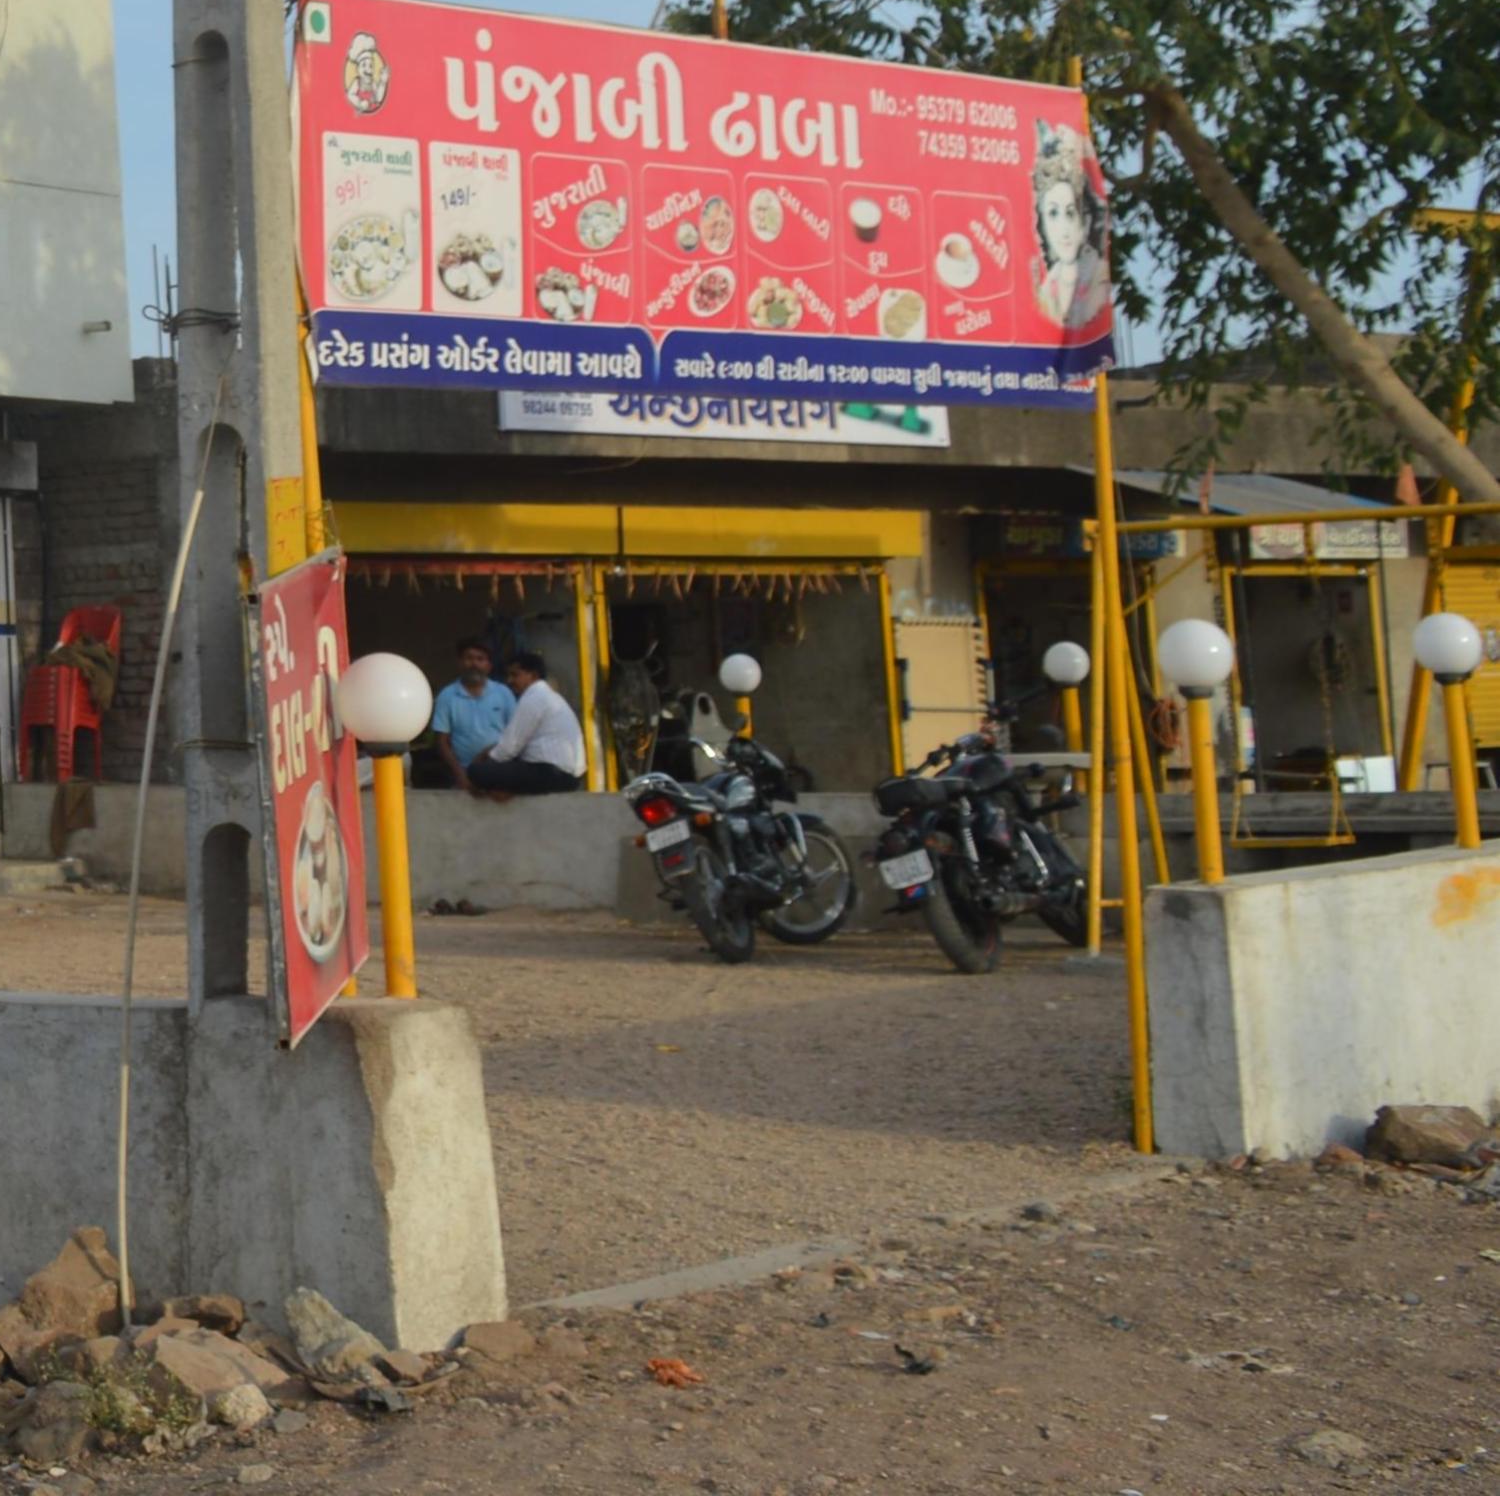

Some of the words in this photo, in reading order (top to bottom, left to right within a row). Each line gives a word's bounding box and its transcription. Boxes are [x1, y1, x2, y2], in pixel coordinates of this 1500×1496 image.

[444, 28, 688, 152] પંજાબી
[709, 89, 863, 169] ઢાબા
[916, 95, 966, 124] 95379
[917, 131, 967, 160] 74359
[532, 163, 607, 229] ગુજરાતી
[579, 258, 630, 298] પંજાબી
[318, 330, 365, 368] દરેક
[371, 333, 430, 370] પ્રસંગ
[437, 335, 499, 373] ઓર્ડર
[577, 343, 642, 379] આવશે
[674, 352, 715, 379] સવારે
[755, 354, 775, 381] થી
